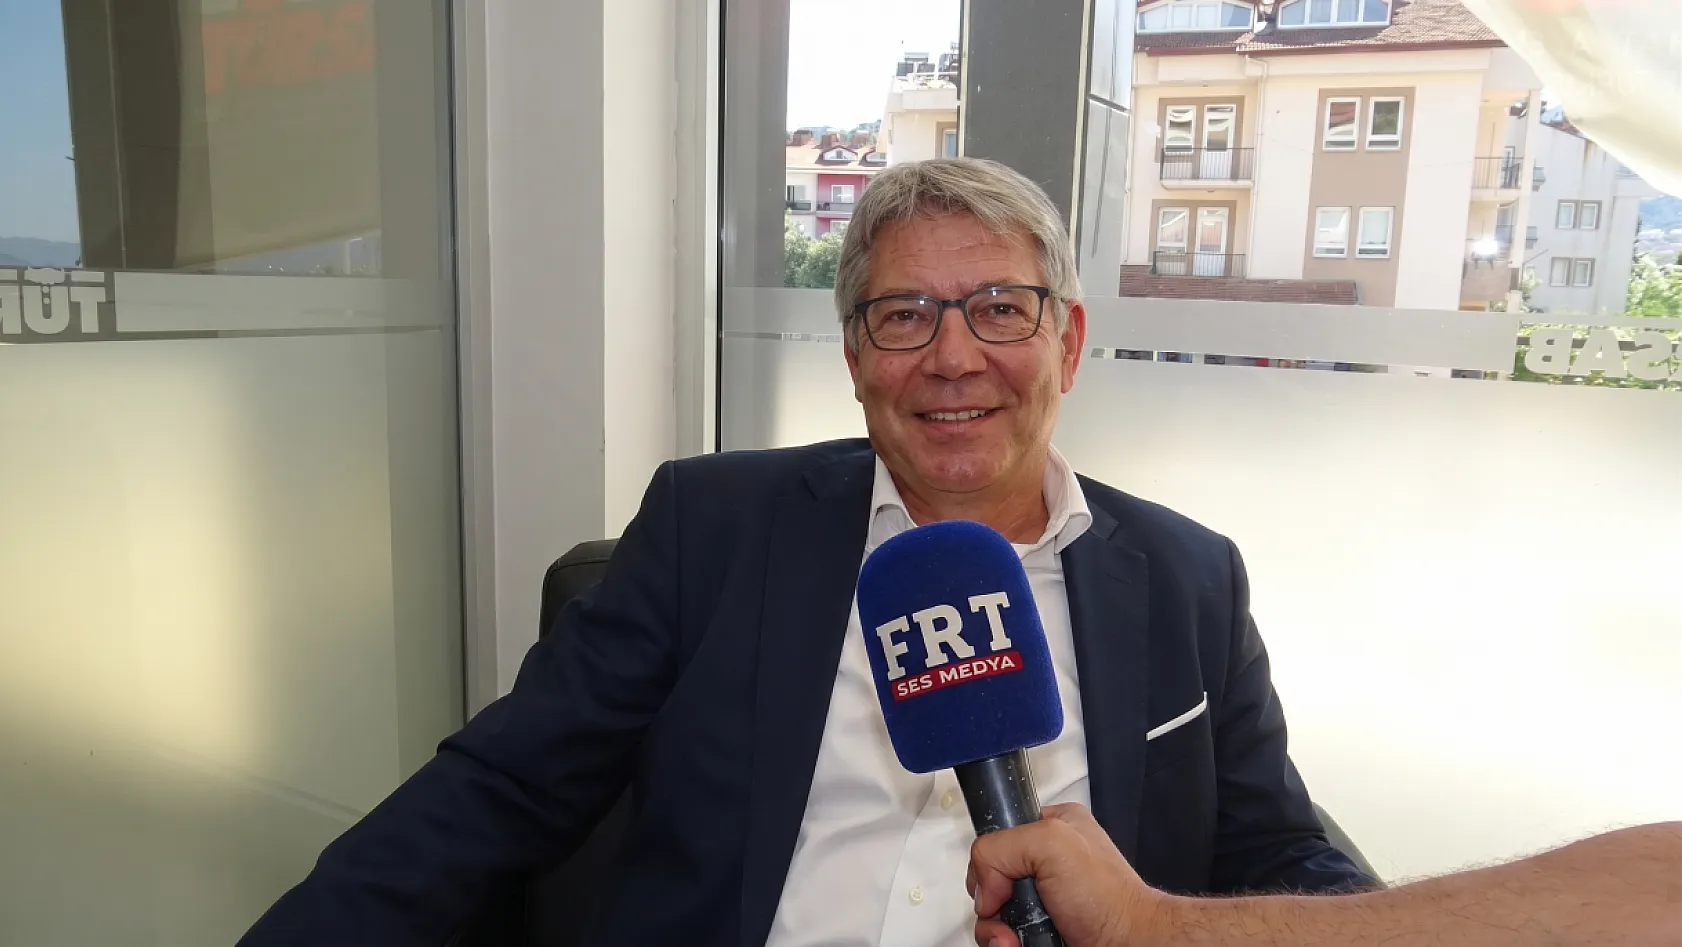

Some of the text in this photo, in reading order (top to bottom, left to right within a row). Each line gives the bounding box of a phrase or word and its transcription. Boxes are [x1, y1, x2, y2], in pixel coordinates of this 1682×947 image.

[876, 591, 1012, 681] FRT
[897, 655, 1016, 697] SES MEDYA
